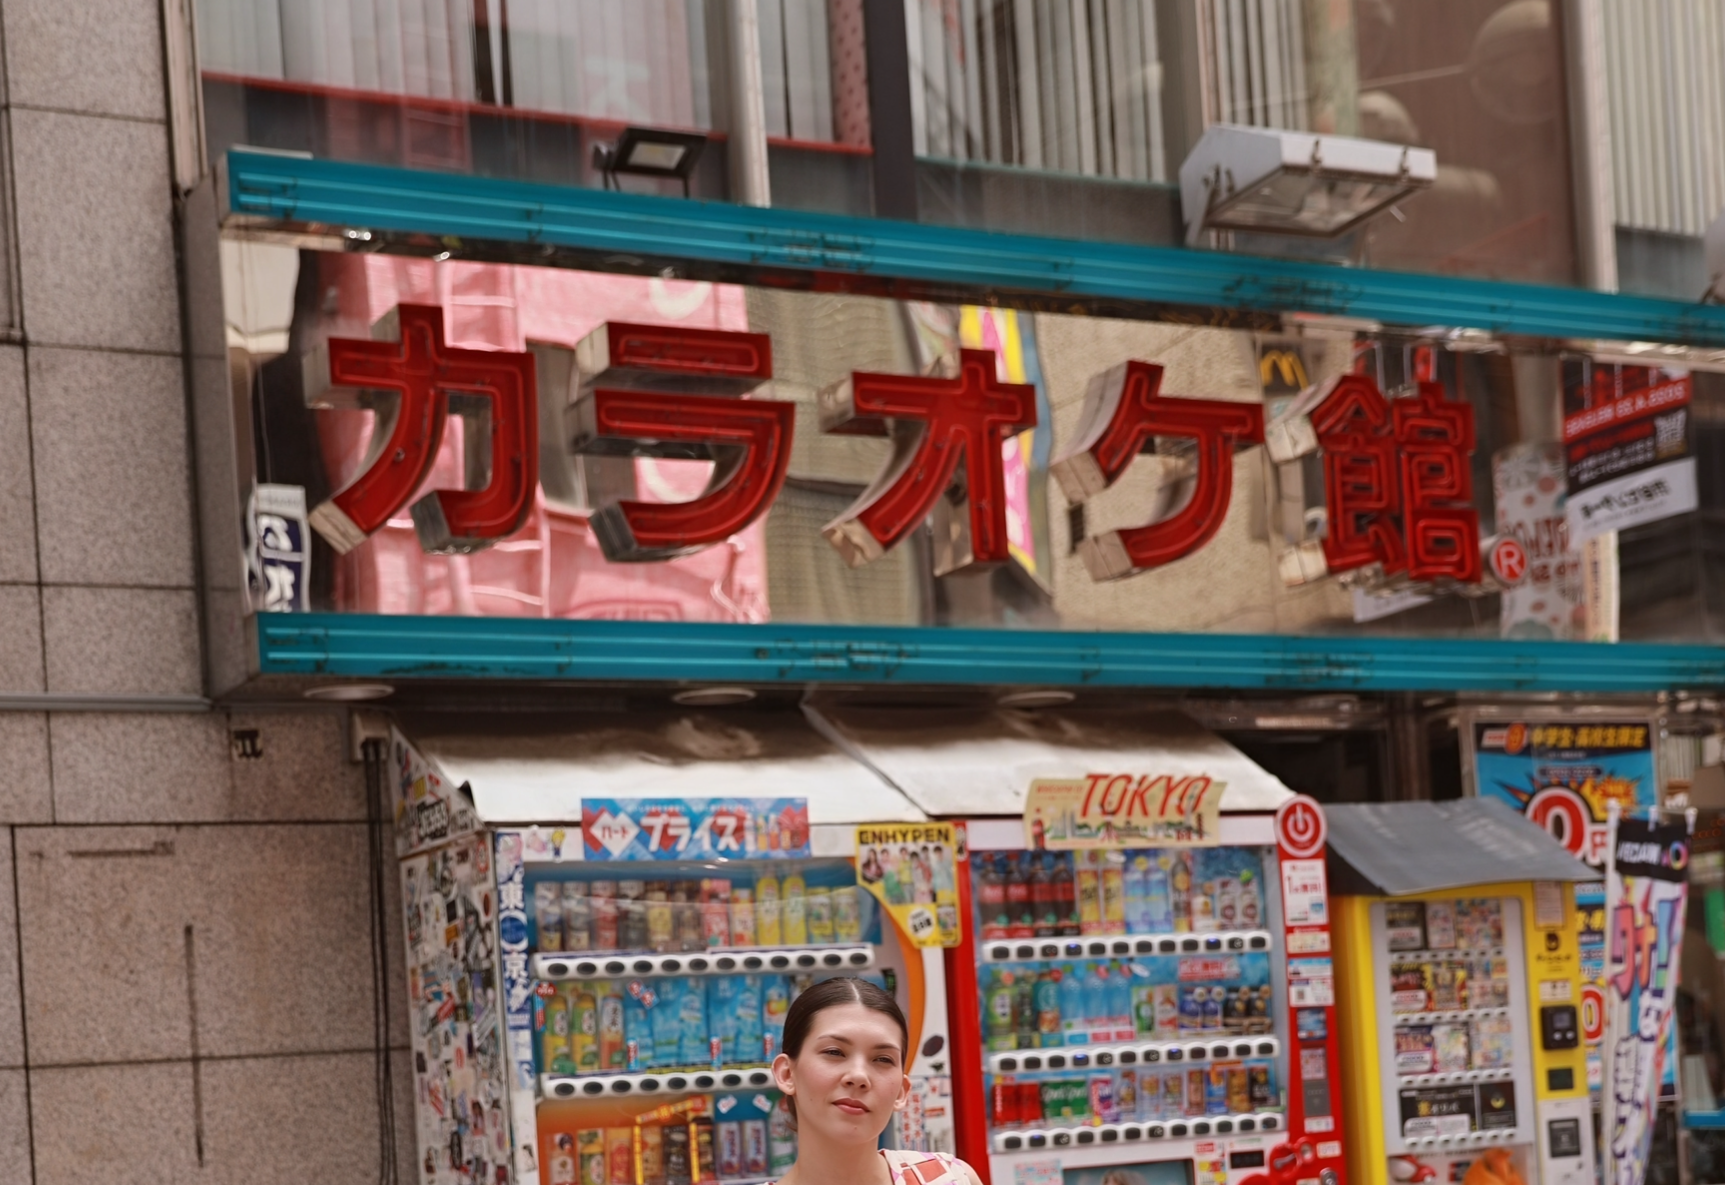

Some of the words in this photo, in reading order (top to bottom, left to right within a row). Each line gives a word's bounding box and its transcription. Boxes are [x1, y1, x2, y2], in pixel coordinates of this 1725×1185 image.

[318, 303, 1482, 583] カラオケ館
[1080, 773, 1212, 818] TOKYO
[639, 813, 741, 852] プライス
[858, 827, 951, 845] ENHYPEN
